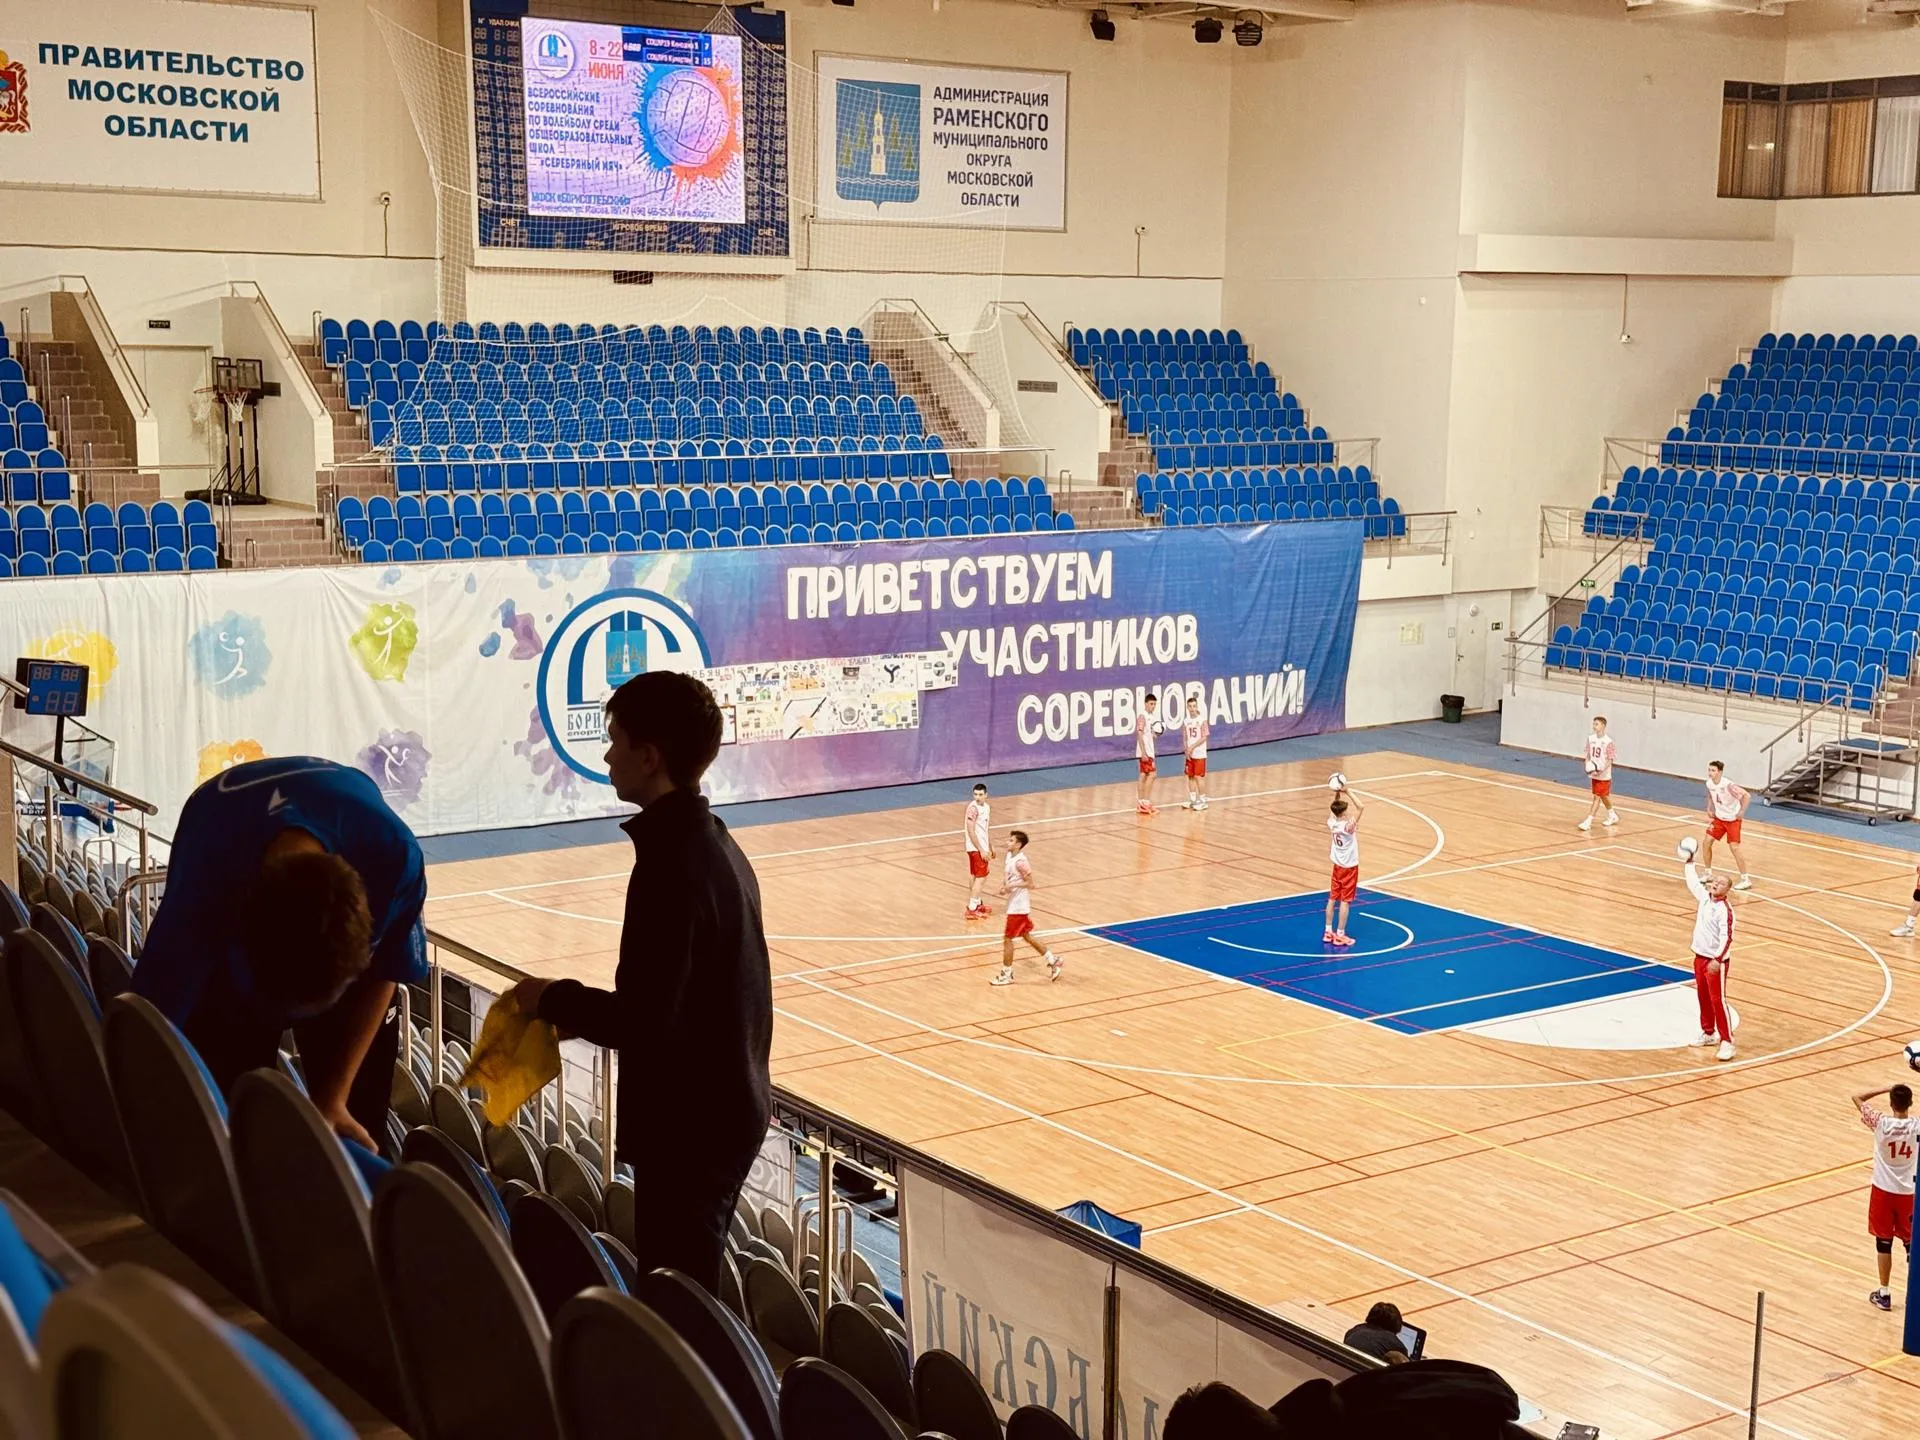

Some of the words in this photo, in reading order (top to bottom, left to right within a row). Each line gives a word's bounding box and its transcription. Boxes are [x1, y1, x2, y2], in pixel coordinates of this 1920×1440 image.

[589, 39, 597, 55] 8
[607, 40, 622, 57] 22
[38, 43, 304, 81] ПРАВИТЕЛЬСТВО
[588, 61, 624, 81] ИЮНЯ
[68, 79, 280, 112] МОСКОВСКОЙ
[527, 87, 600, 103] ВСЕРОССИЙСКИЕ
[933, 86, 1049, 107] АДМИНИСТРАЦИЯ
[528, 101, 595, 116] СОРЕВНОВАНИЯ
[528, 115, 541, 126] ПО
[543, 116, 591, 129] ВОЛЕЙБОЛУ
[593, 120, 620, 131] СРЕДИ
[933, 107, 1049, 132] РАМЕНСКОГО
[104, 115, 249, 143] ОБЛАСТИ
[529, 129, 633, 145] ОБЩЕОБРАЗОВАТЕЛЬНЫХ
[529, 142, 555, 154] ШКОЛ
[966, 153, 1012, 168] ОКРУГА
[947, 171, 1033, 188] МОСКОВСКОЙ
[961, 192, 1020, 208] ОБЛАСТИ
[786, 550, 1113, 621] ПРИВЕТСТВУЕМ
[940, 614, 1199, 678] УЧАСТНИКОВ
[1189, 727, 1197, 738] 15
[1592, 746, 1602, 758] 19
[1888, 1141, 1912, 1159] 14
